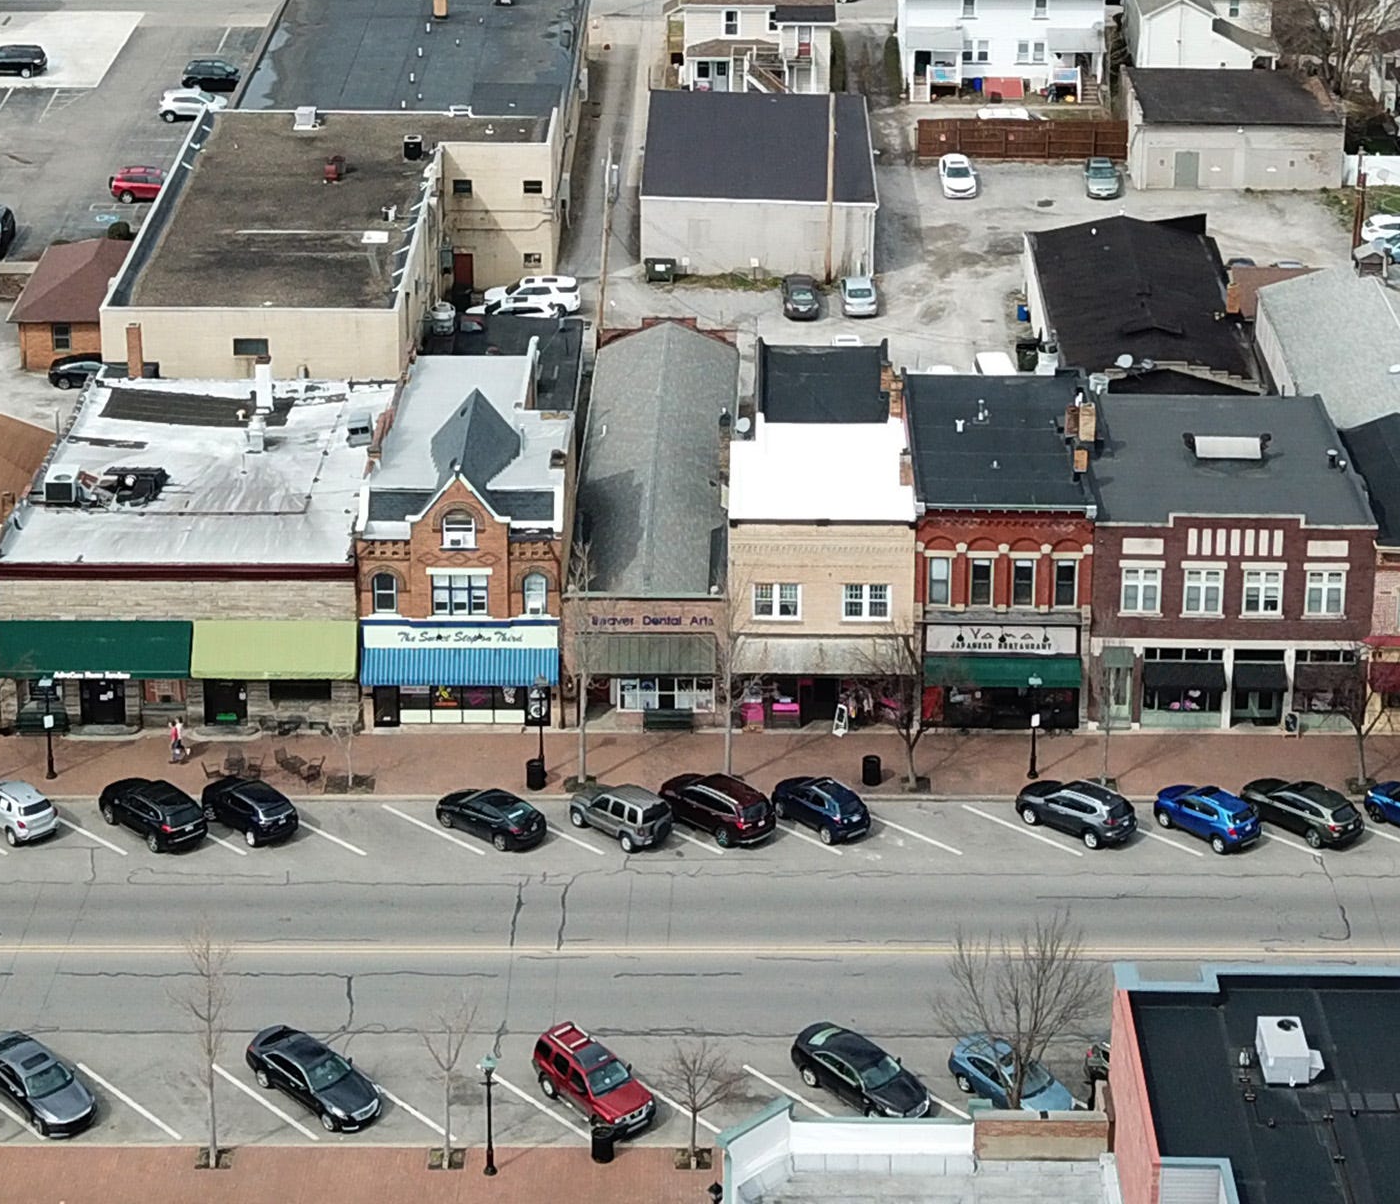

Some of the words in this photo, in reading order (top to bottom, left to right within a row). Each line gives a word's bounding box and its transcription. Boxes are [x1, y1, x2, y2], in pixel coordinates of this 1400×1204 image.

[592, 616, 634, 626] Beaver
[642, 615, 682, 626] Dental
[690, 616, 714, 626] Arts
[397, 631, 416, 642] The
[494, 631, 523, 642] Third
[950, 642, 993, 650] JAPANESE
[998, 642, 1052, 650] RESTAURANT
